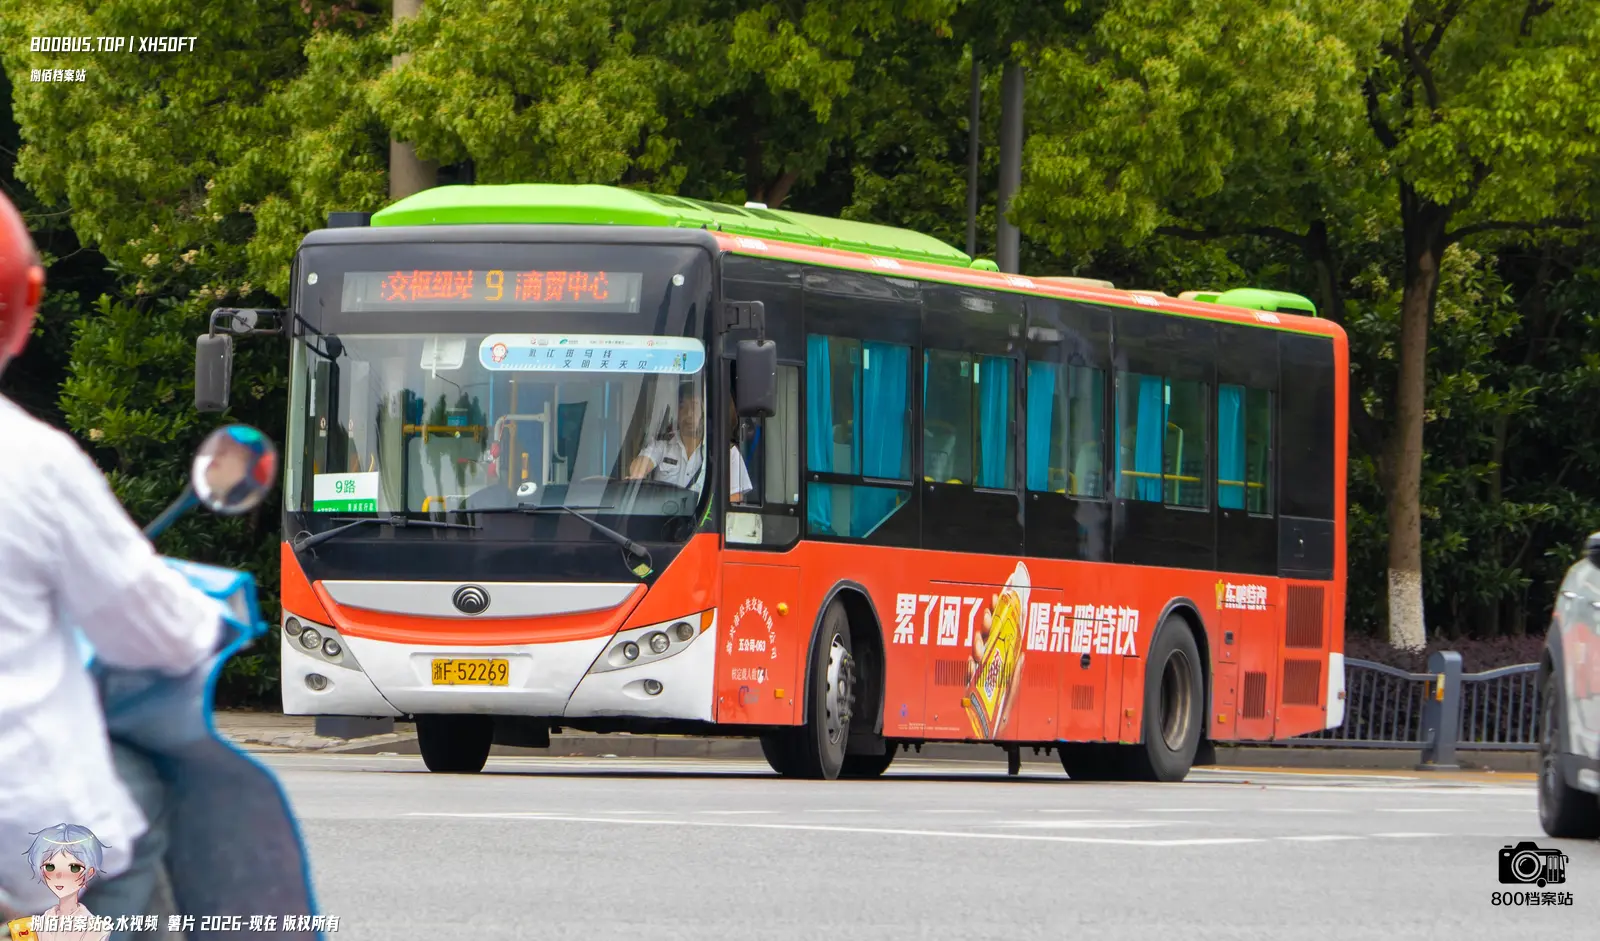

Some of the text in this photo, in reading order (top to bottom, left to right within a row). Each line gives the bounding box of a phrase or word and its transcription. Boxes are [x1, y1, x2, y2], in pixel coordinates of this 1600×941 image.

[485, 269, 505, 301] 9
[335, 480, 356, 494] 9路
[892, 593, 1140, 656] 累了困了 喝东鹏特饮
